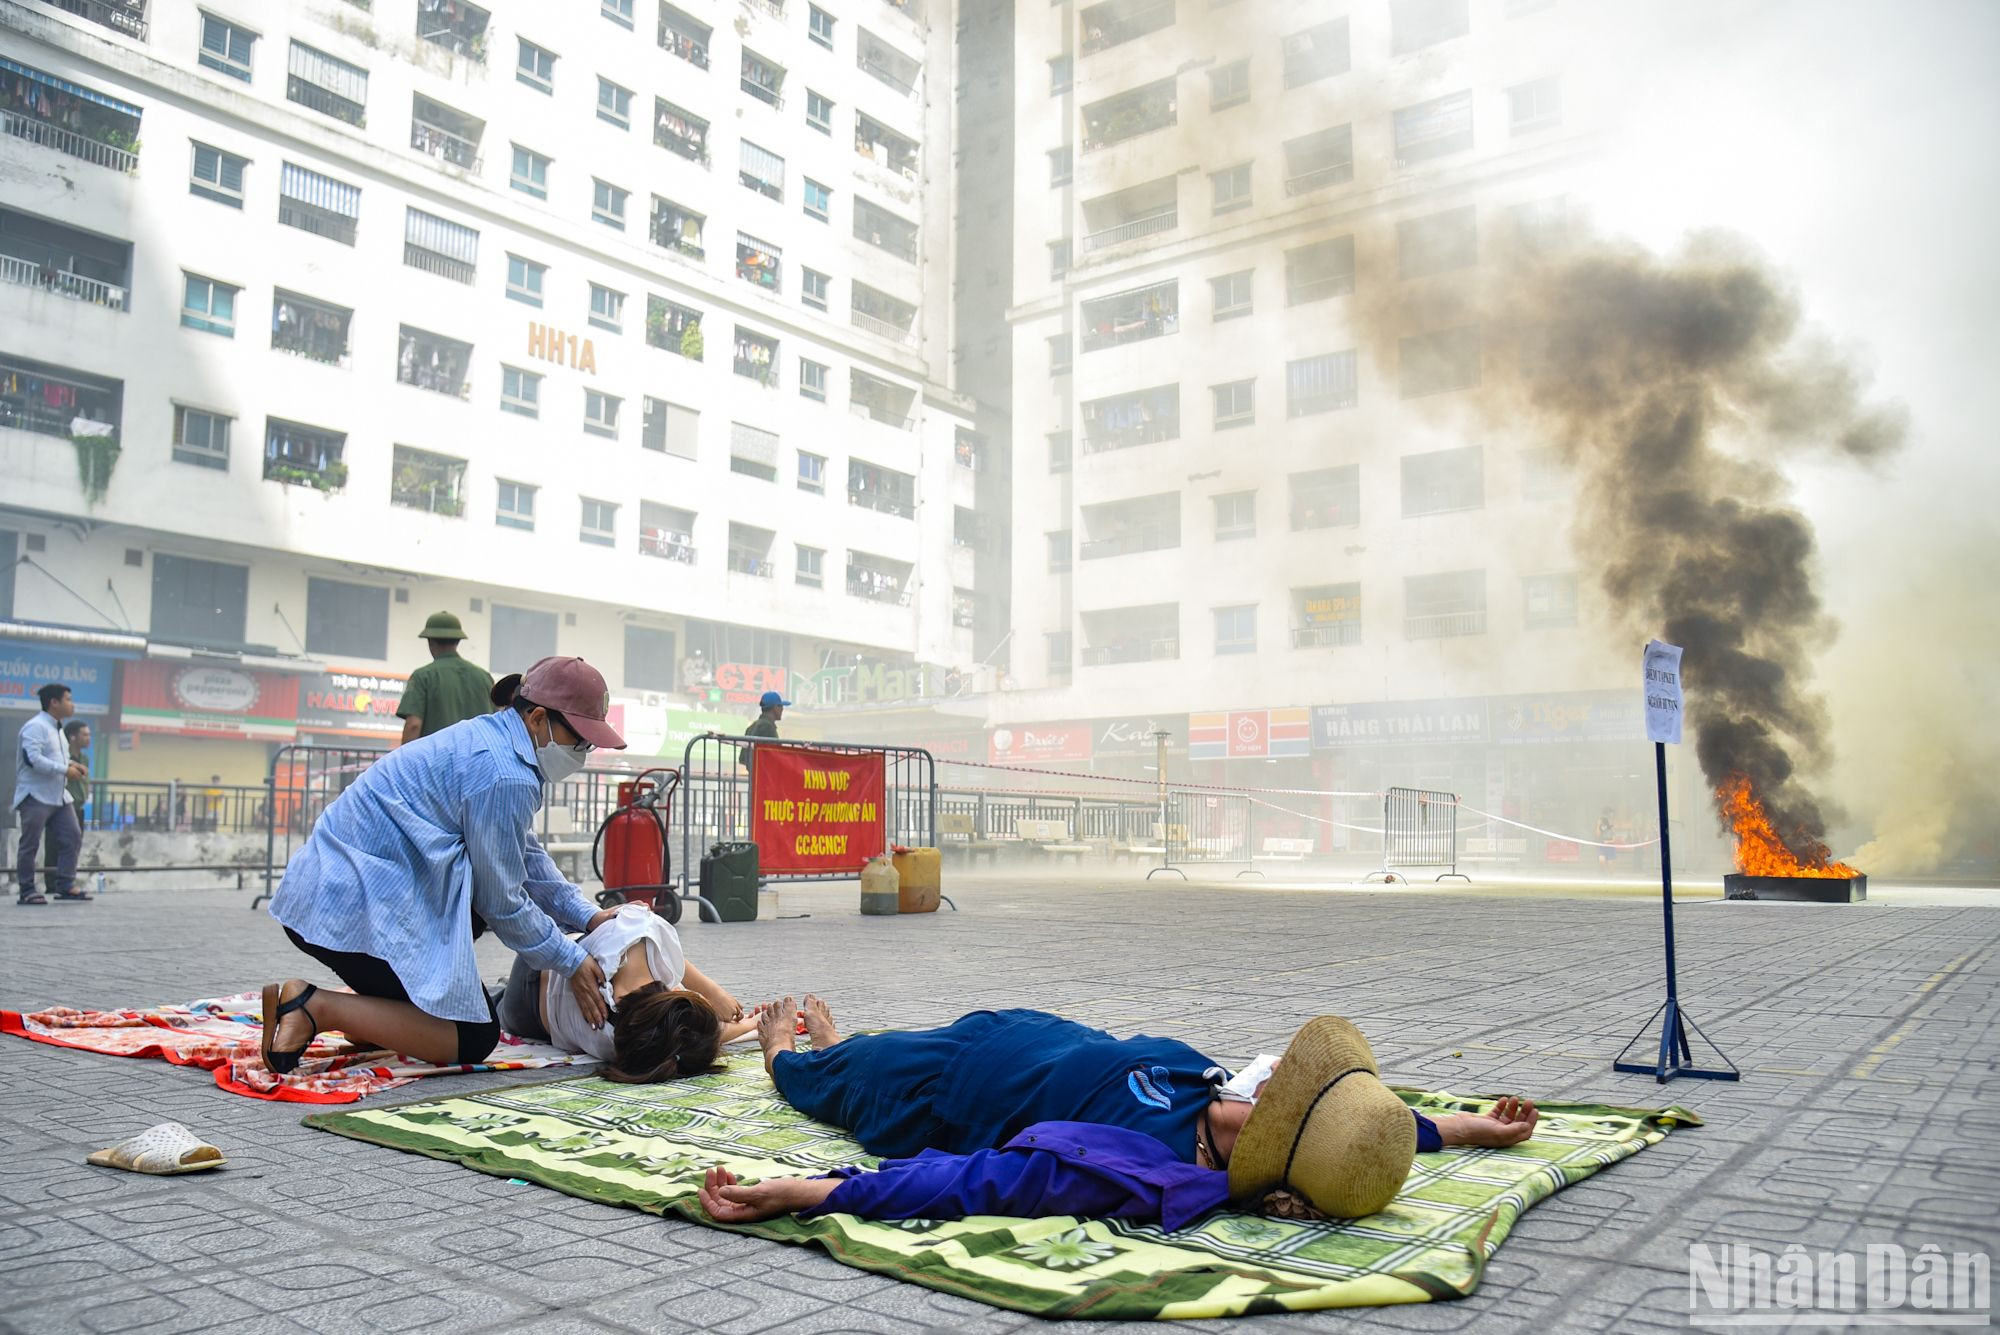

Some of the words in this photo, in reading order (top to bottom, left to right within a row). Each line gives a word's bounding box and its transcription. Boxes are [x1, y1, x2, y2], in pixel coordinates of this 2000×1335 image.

[528, 321, 597, 376] HH1A
[33, 663, 60, 681] CAO
[204, 674, 232, 686] pizza
[359, 676, 379, 689] GÀ
[715, 664, 786, 695] GYM
[859, 662, 932, 704] Mart
[1326, 717, 1379, 737] HÀNG
[1385, 713, 1432, 734] THÁI
[1439, 713, 1480, 732] LAN
[803, 769, 827, 790] KHU
[828, 770, 850, 795] VỰC
[764, 798, 794, 826] THỰC
[797, 798, 819, 827] TẬP
[818, 801, 860, 823] PHƯƠNG
[861, 799, 876, 822] ÁN
